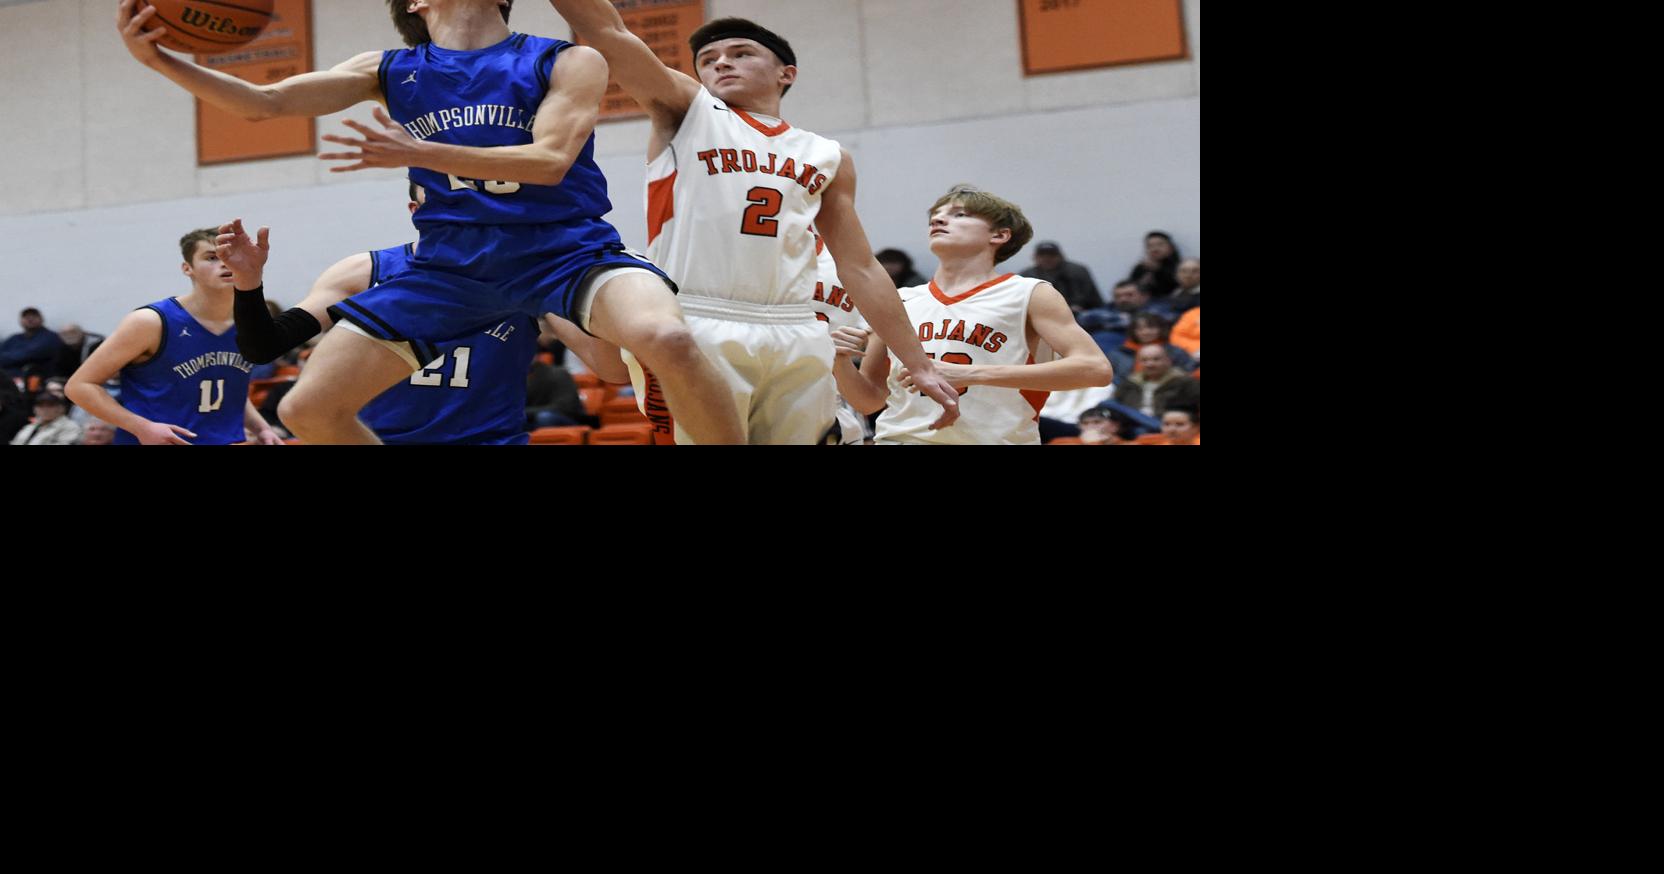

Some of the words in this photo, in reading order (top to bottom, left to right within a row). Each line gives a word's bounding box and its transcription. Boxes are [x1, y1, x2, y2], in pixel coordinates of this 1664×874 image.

[697, 148, 827, 196] TROJANS
[740, 186, 784, 238] 2
[812, 281, 855, 313] ANS
[918, 318, 1008, 353] OJANS
[410, 346, 471, 388] 21
